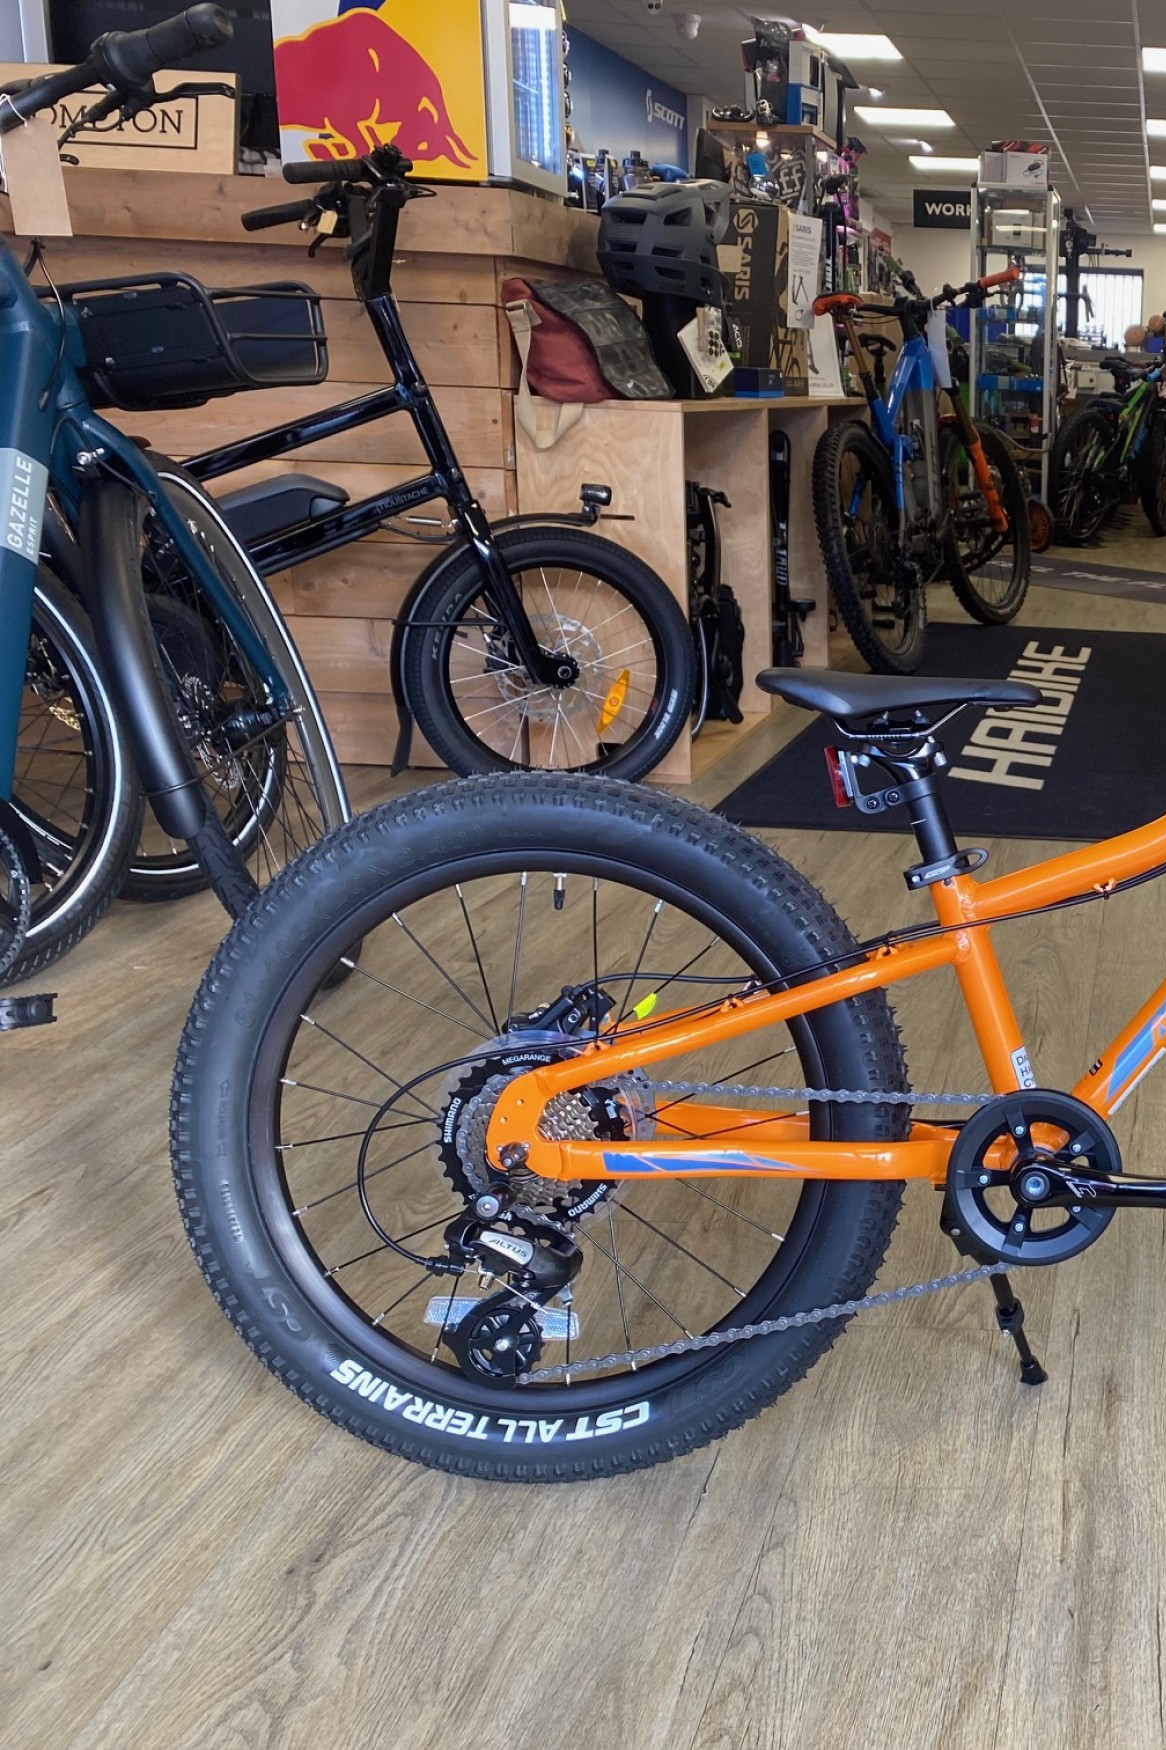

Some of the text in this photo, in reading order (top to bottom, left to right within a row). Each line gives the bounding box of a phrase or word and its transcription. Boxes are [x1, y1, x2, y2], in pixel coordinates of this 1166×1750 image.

[654, 102, 685, 130] SCOTT
[735, 236, 753, 301] SARIS
[7, 456, 33, 549] GAZELLE
[26, 515, 38, 556] ESPRIT
[501, 1053, 552, 1066] MEGARANGE
[443, 1097, 462, 1144] SHIMANO
[567, 1182, 608, 1218] SHIMANO
[488, 1238, 529, 1259] ALTUS
[330, 1359, 650, 1443] CST ALL TERRAINS
